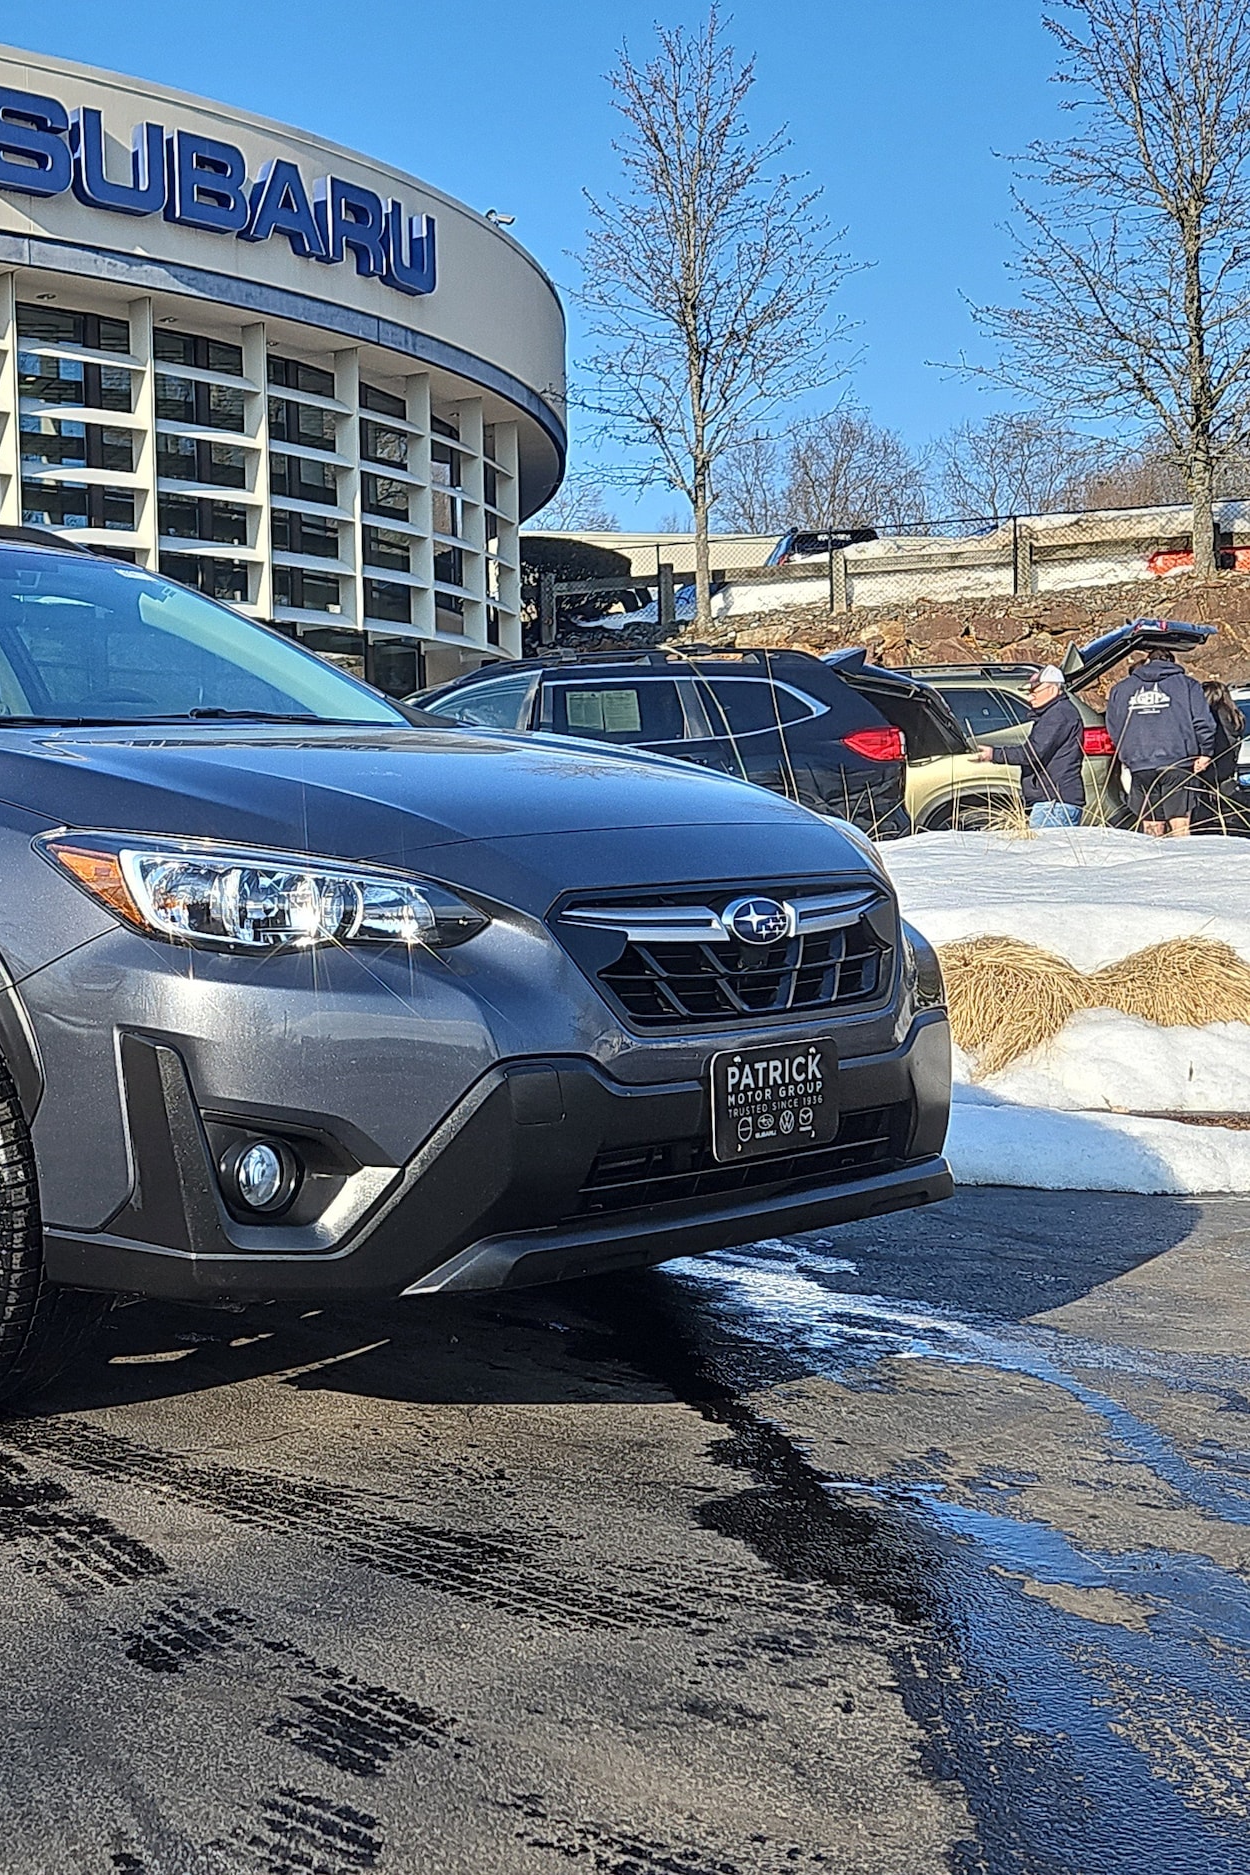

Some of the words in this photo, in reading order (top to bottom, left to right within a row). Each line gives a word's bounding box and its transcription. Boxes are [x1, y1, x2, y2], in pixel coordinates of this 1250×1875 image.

[726, 1053, 823, 1093] PATRICK
[727, 1088, 772, 1107] MOTOR
[778, 1080, 823, 1098] GROUP
[727, 1103, 768, 1119] TRUSTED
[771, 1097, 799, 1111] SINCE
